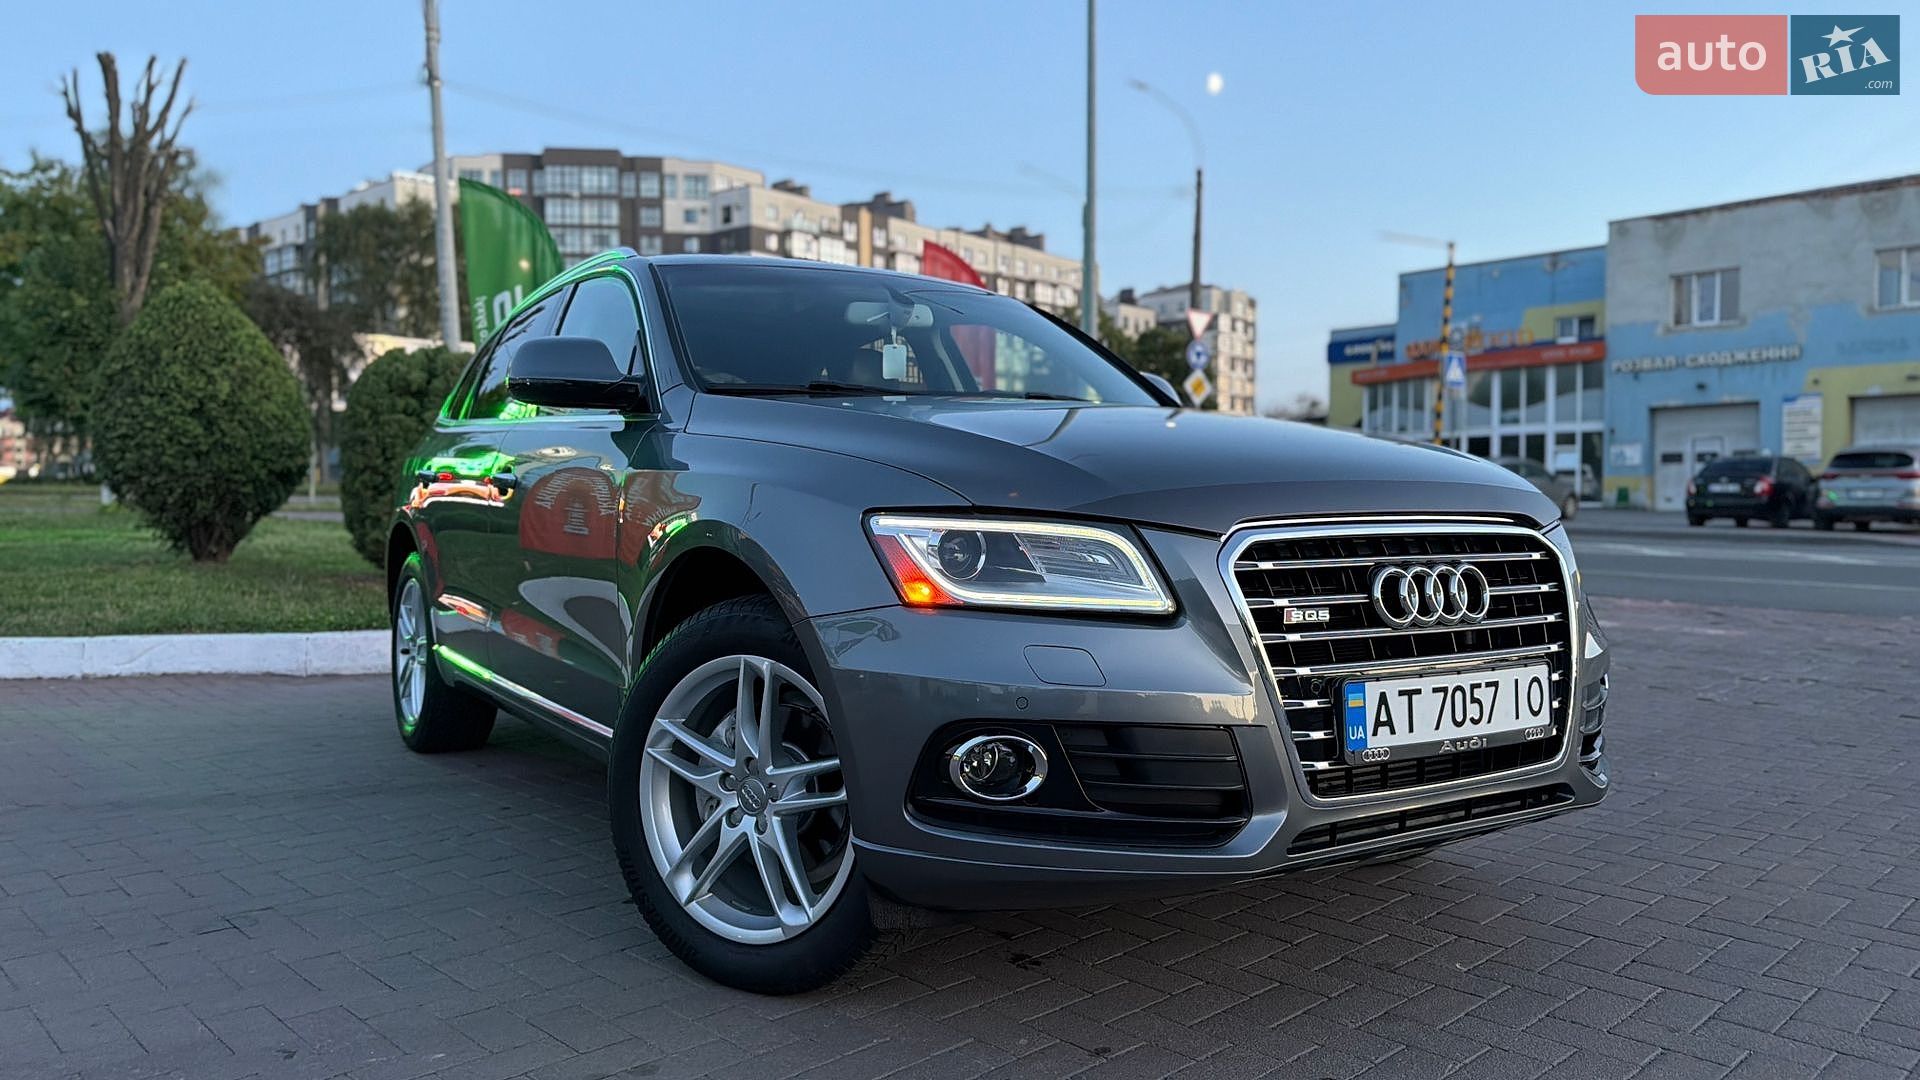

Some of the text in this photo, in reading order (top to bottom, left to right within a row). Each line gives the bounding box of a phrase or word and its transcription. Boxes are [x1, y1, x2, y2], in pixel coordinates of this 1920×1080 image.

[1289, 609, 1330, 622] SQ5
[1371, 687, 1422, 737] AT
[1432, 679, 1500, 731] 7057
[1349, 726, 1366, 740] UA
